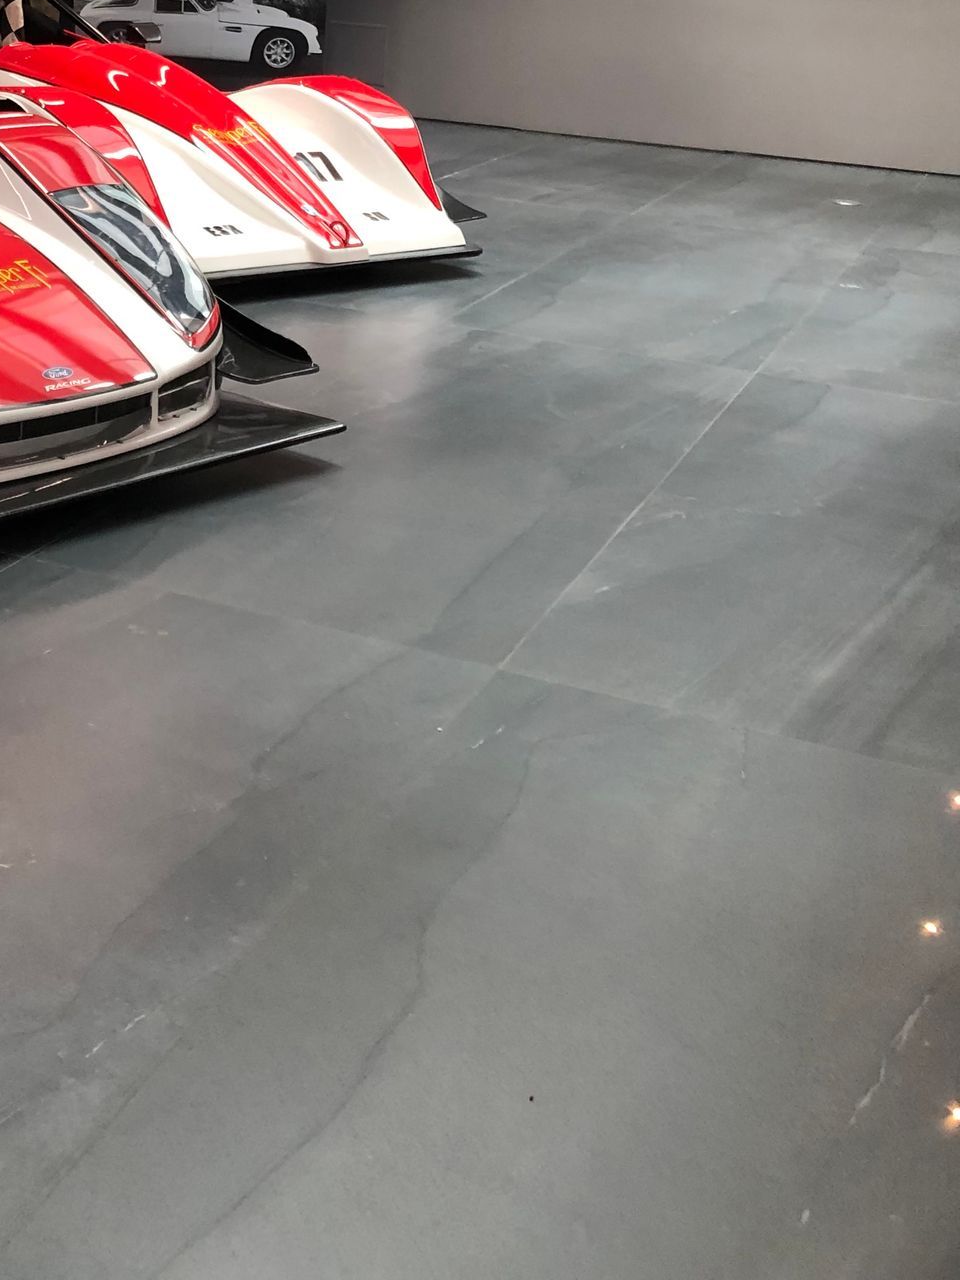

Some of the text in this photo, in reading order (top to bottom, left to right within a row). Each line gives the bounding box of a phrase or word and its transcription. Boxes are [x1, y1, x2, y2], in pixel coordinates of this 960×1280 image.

[293, 151, 344, 182] 17
[48, 369, 68, 379] Ford
[44, 377, 92, 392] RACING
